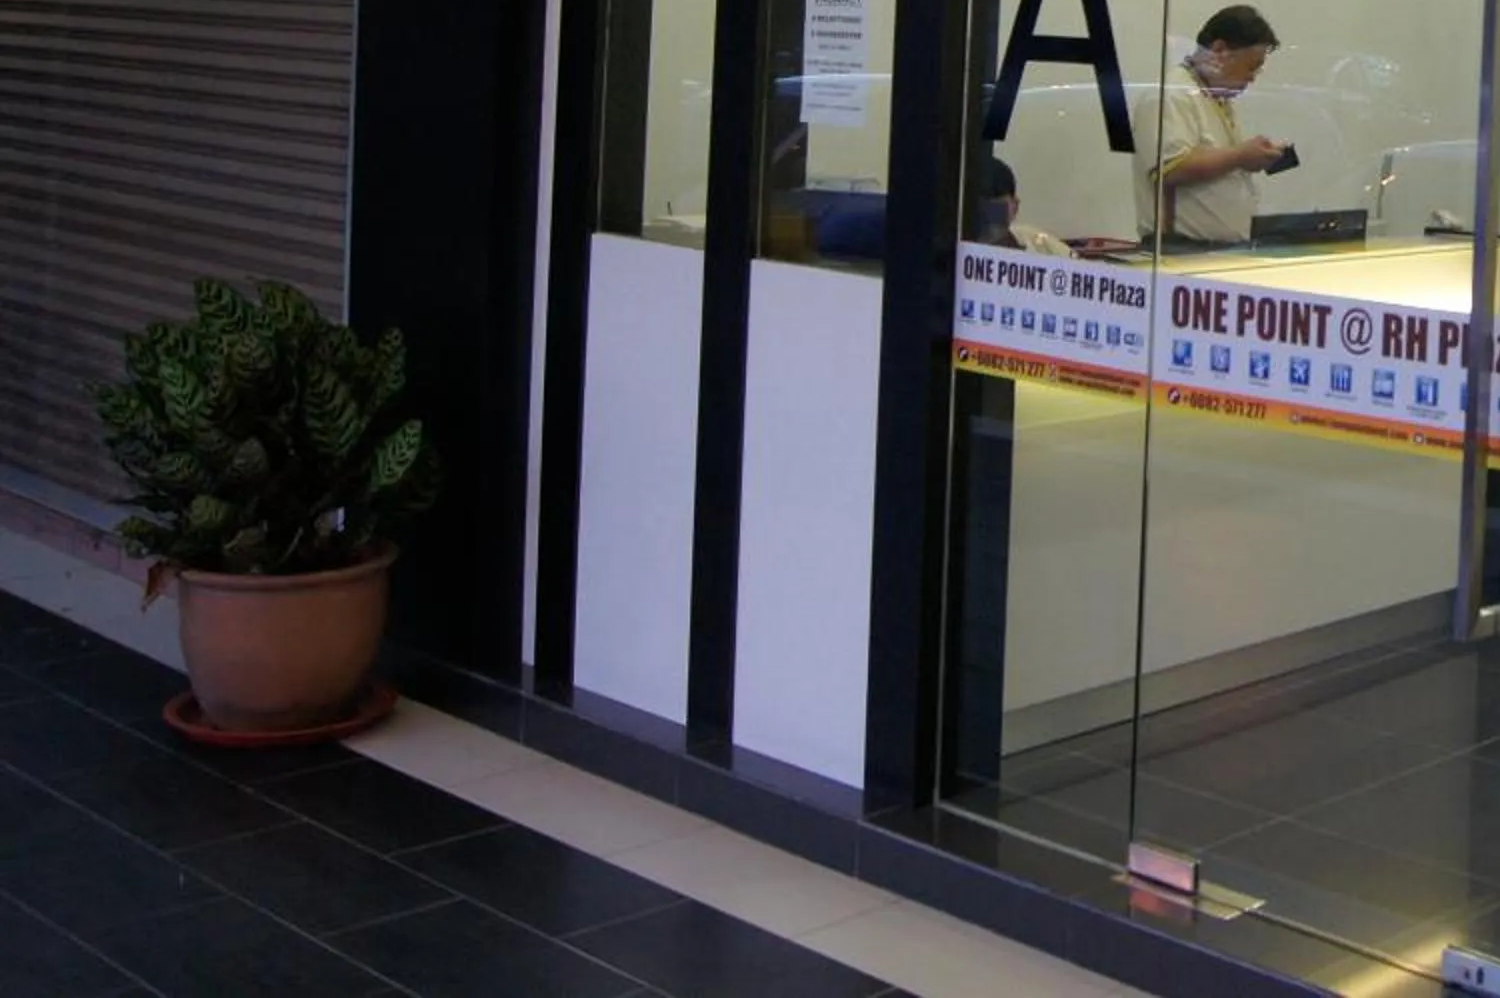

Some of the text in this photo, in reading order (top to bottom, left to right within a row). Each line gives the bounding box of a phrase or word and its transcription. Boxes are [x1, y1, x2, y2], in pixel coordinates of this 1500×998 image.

[963, 254, 1146, 309] ONE POINT @ RH Plaza
[1171, 285, 1228, 334] ONE
[1236, 294, 1332, 349] POINT
[1340, 307, 1373, 355] @
[1382, 313, 1429, 363] RH
